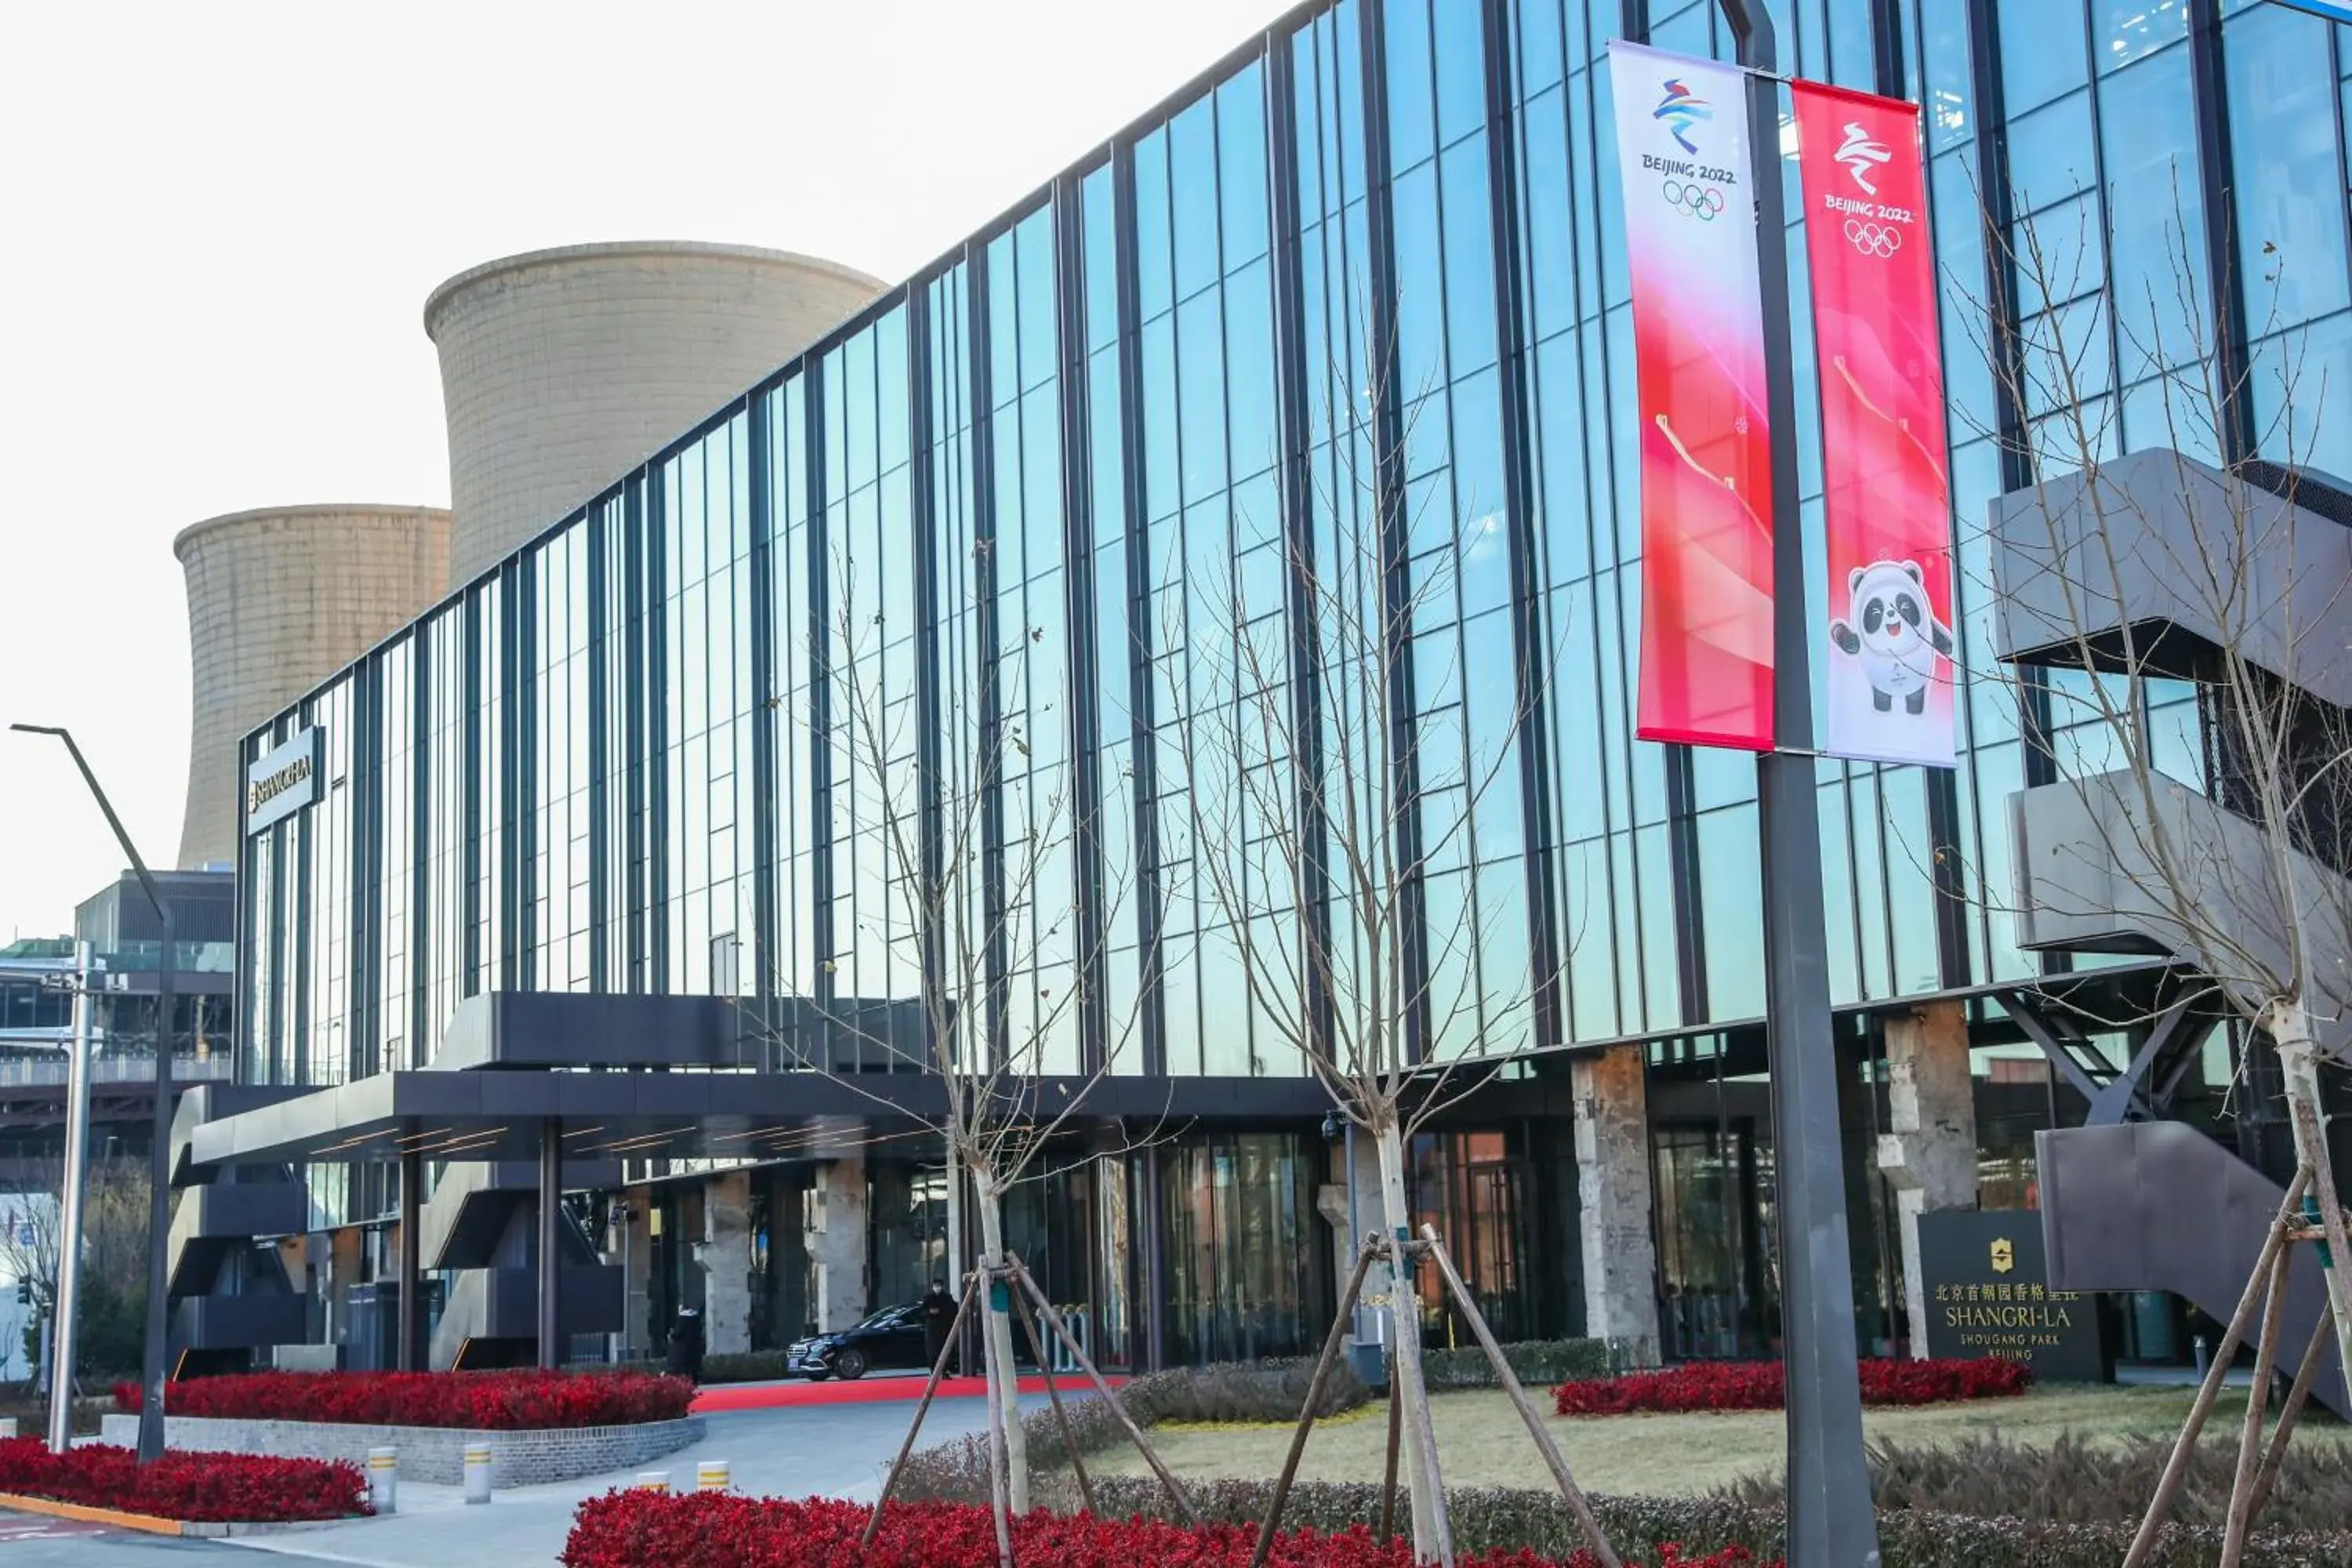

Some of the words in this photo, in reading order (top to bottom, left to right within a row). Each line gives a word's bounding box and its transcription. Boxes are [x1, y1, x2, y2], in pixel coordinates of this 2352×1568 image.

[1643, 154, 1694, 178] BEIJING
[1699, 165, 1737, 184] 2022
[1825, 194, 1874, 217] BEIJING
[1878, 205, 1914, 223] 2022
[1946, 1307, 2071, 1327] SHANGRI-LA
[1960, 1334, 2025, 1345] SHOUGANG
[2031, 1334, 2060, 1345] PARK
